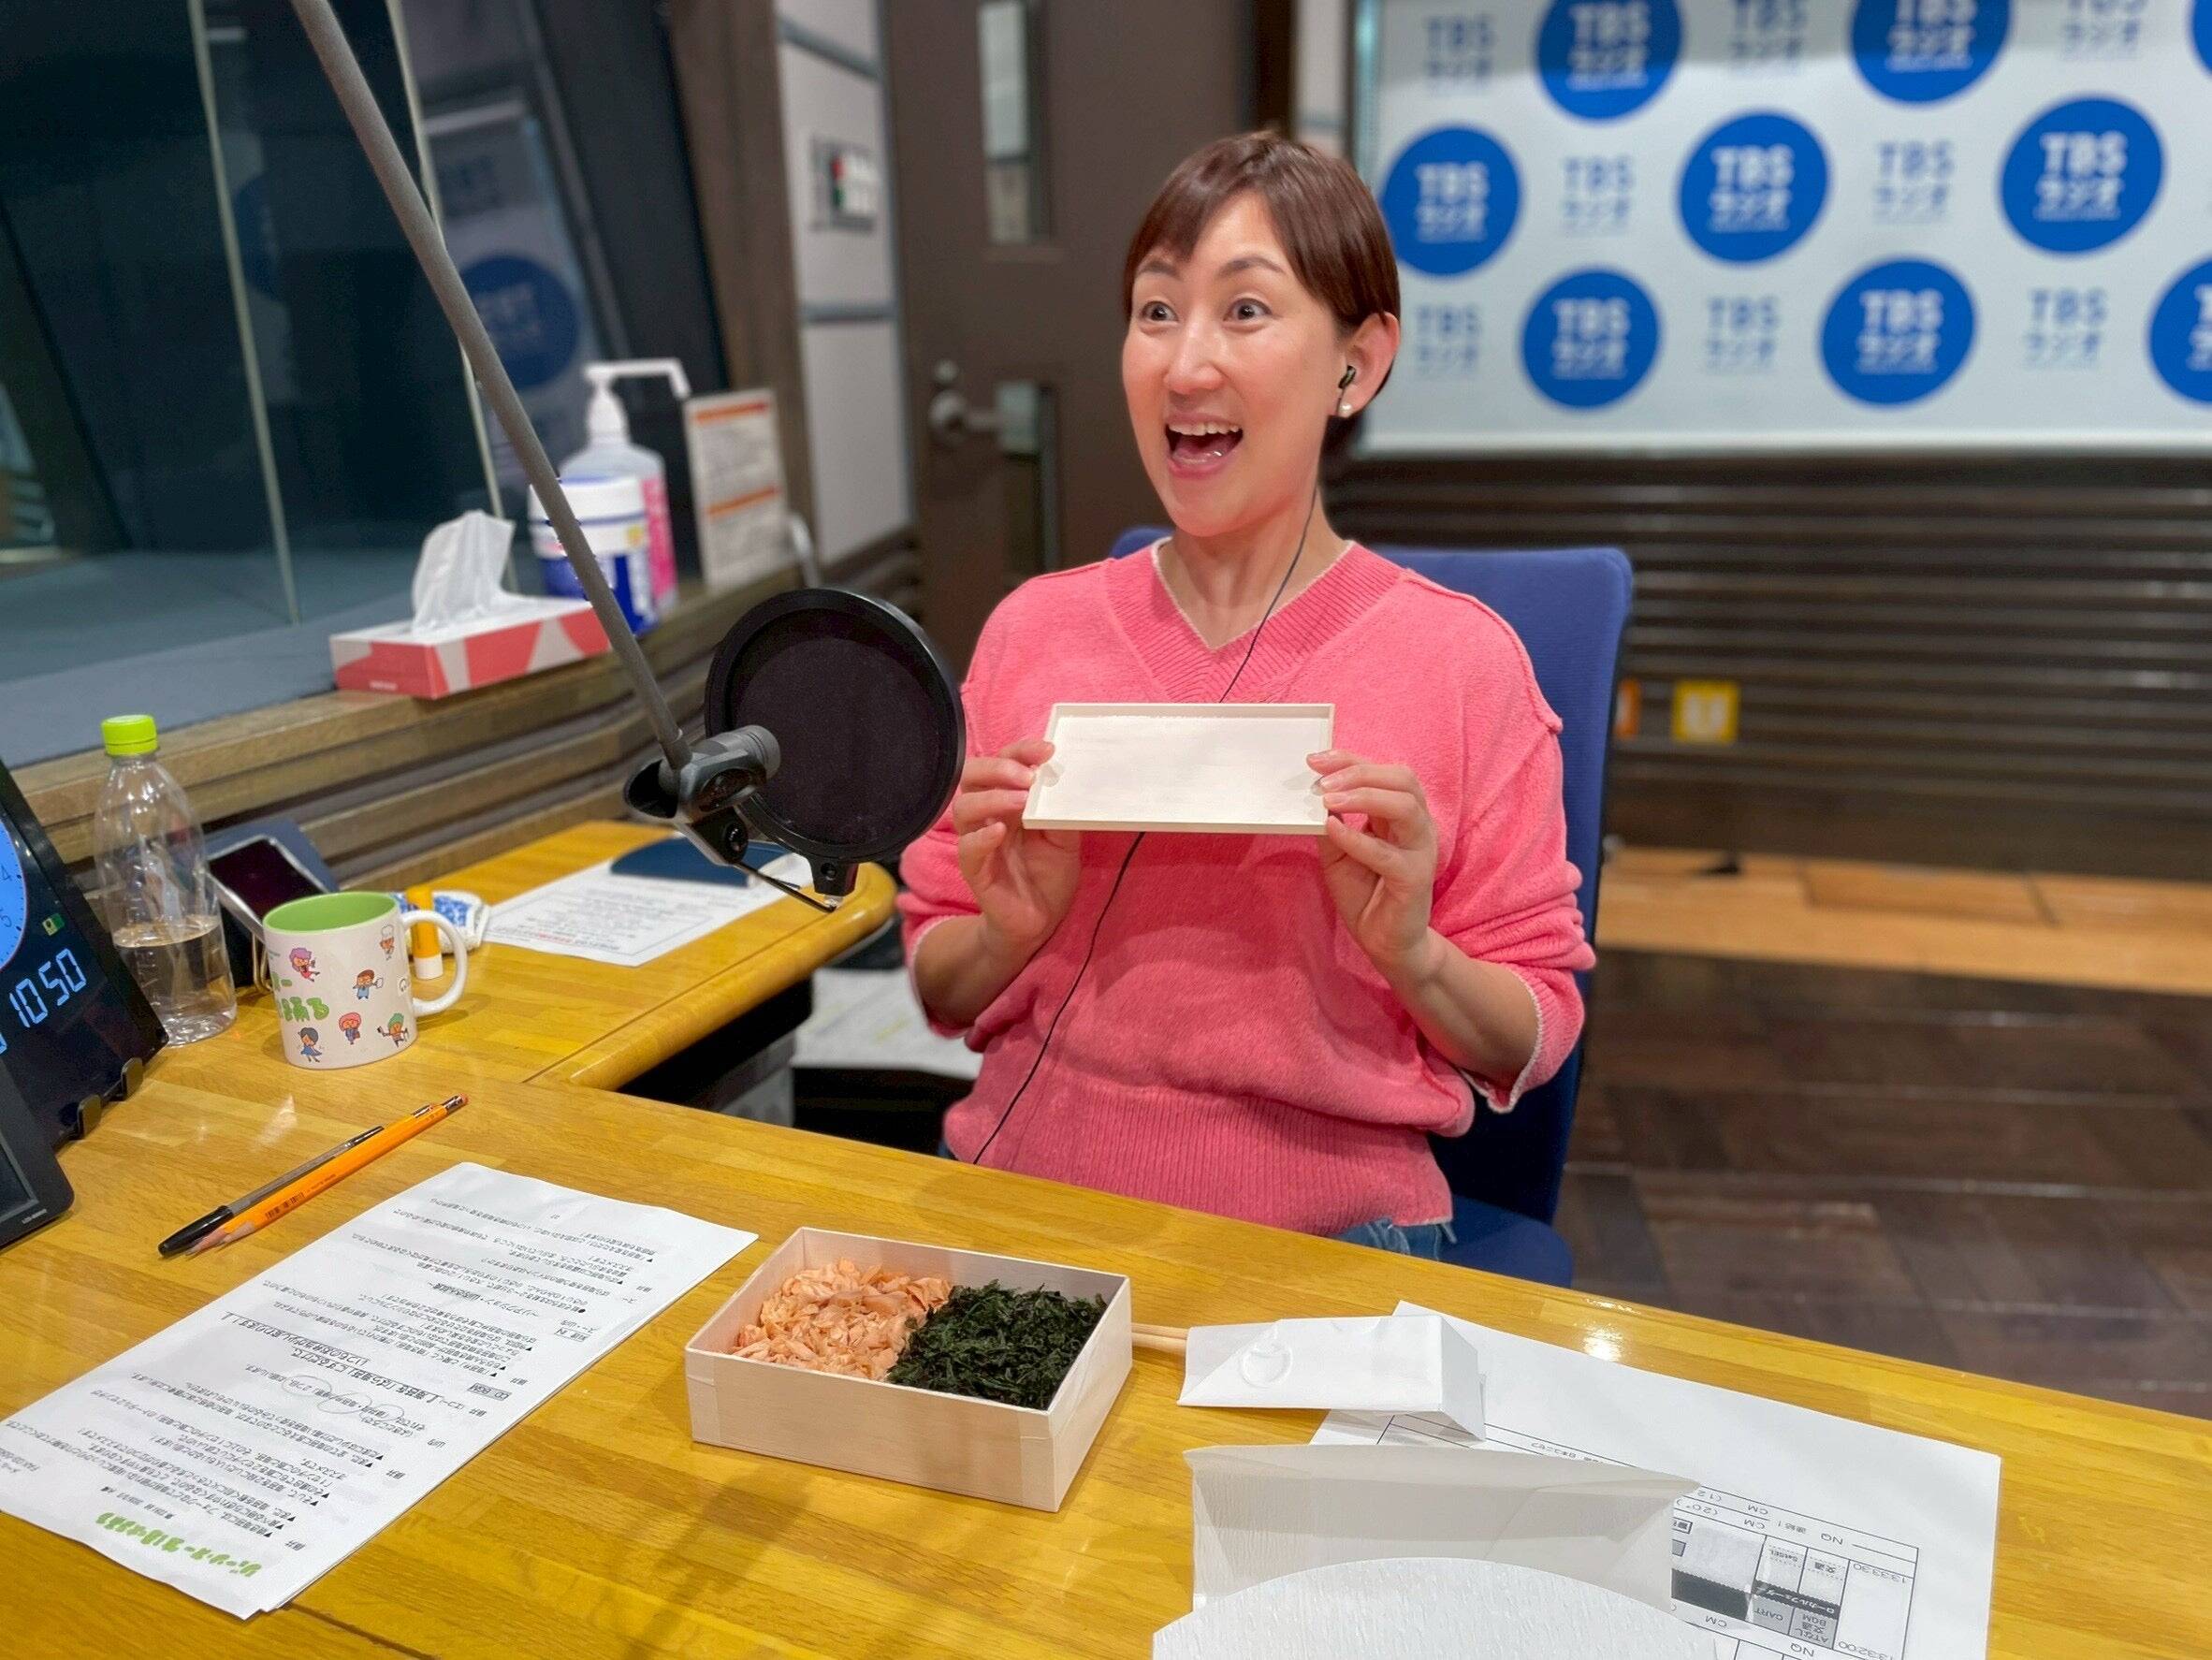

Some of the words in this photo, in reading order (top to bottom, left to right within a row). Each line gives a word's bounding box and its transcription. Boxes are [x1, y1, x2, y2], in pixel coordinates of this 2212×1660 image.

[2039, 130, 2127, 177] TBS
[1710, 143, 1794, 190] TBS
[1415, 161, 1490, 200] TBS
[1551, 298, 1629, 339] TBS
[1859, 289, 1943, 334] TBS
[1748, 1504, 1768, 1516] CM
[1743, 1519, 1766, 1530] CM
[1821, 1533, 1843, 1546] NQ
[1705, 1615, 1727, 1628] CM
[1753, 1607, 1784, 1622] CART
[1802, 1613, 1827, 1625] BGM
[1790, 1642, 1815, 1657] NQ
